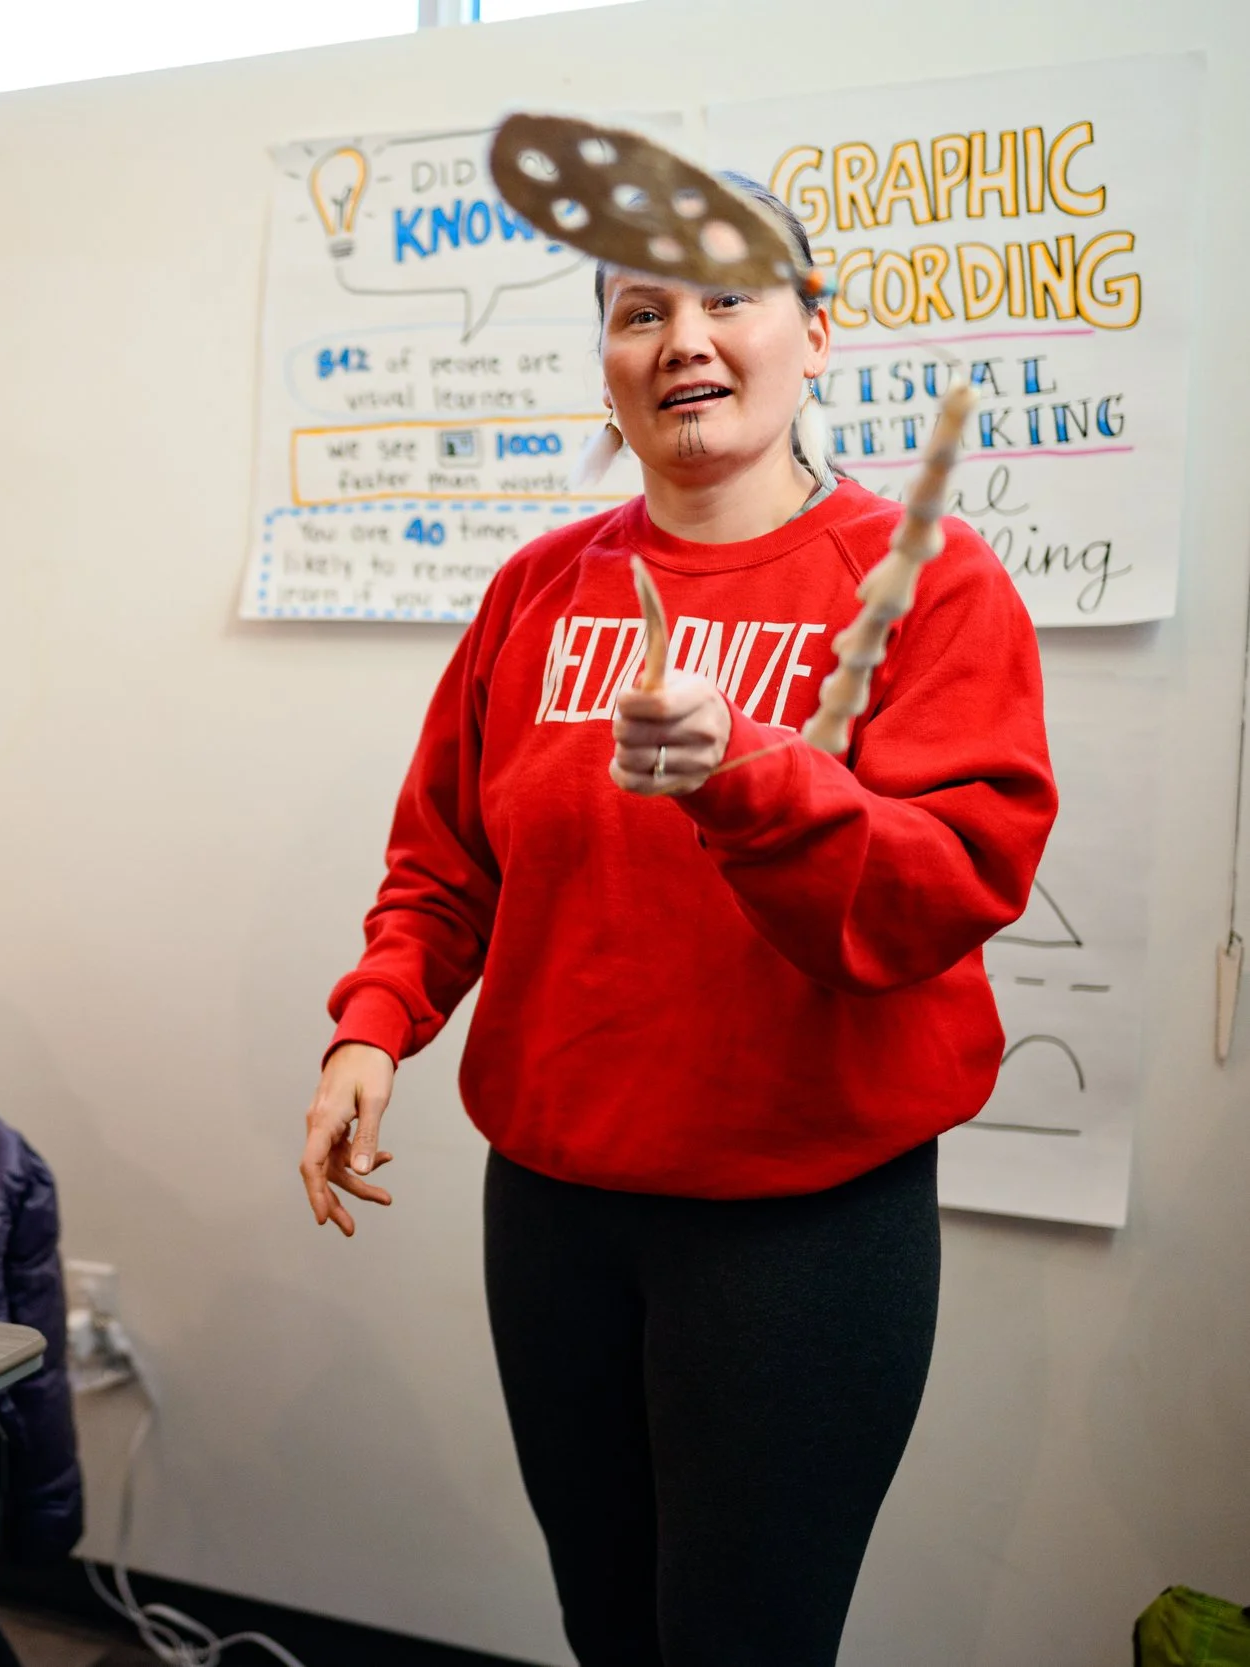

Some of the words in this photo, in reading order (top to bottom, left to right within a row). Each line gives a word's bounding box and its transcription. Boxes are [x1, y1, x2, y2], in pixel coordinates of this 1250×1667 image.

[412, 158, 477, 193] DID
[770, 121, 1107, 236] GRAPHIC
[812, 230, 1142, 330] CORDING
[385, 347, 413, 373] of
[430, 353, 500, 378] people
[517, 351, 563, 375] are
[813, 354, 1058, 408] VISUAL
[346, 385, 414, 412] visual
[433, 385, 537, 411] learners
[378, 439, 417, 463] see
[495, 431, 563, 460] 1000
[338, 468, 410, 492] faster
[351, 522, 392, 544] are
[403, 516, 447, 547] 40
[370, 551, 397, 577] to
